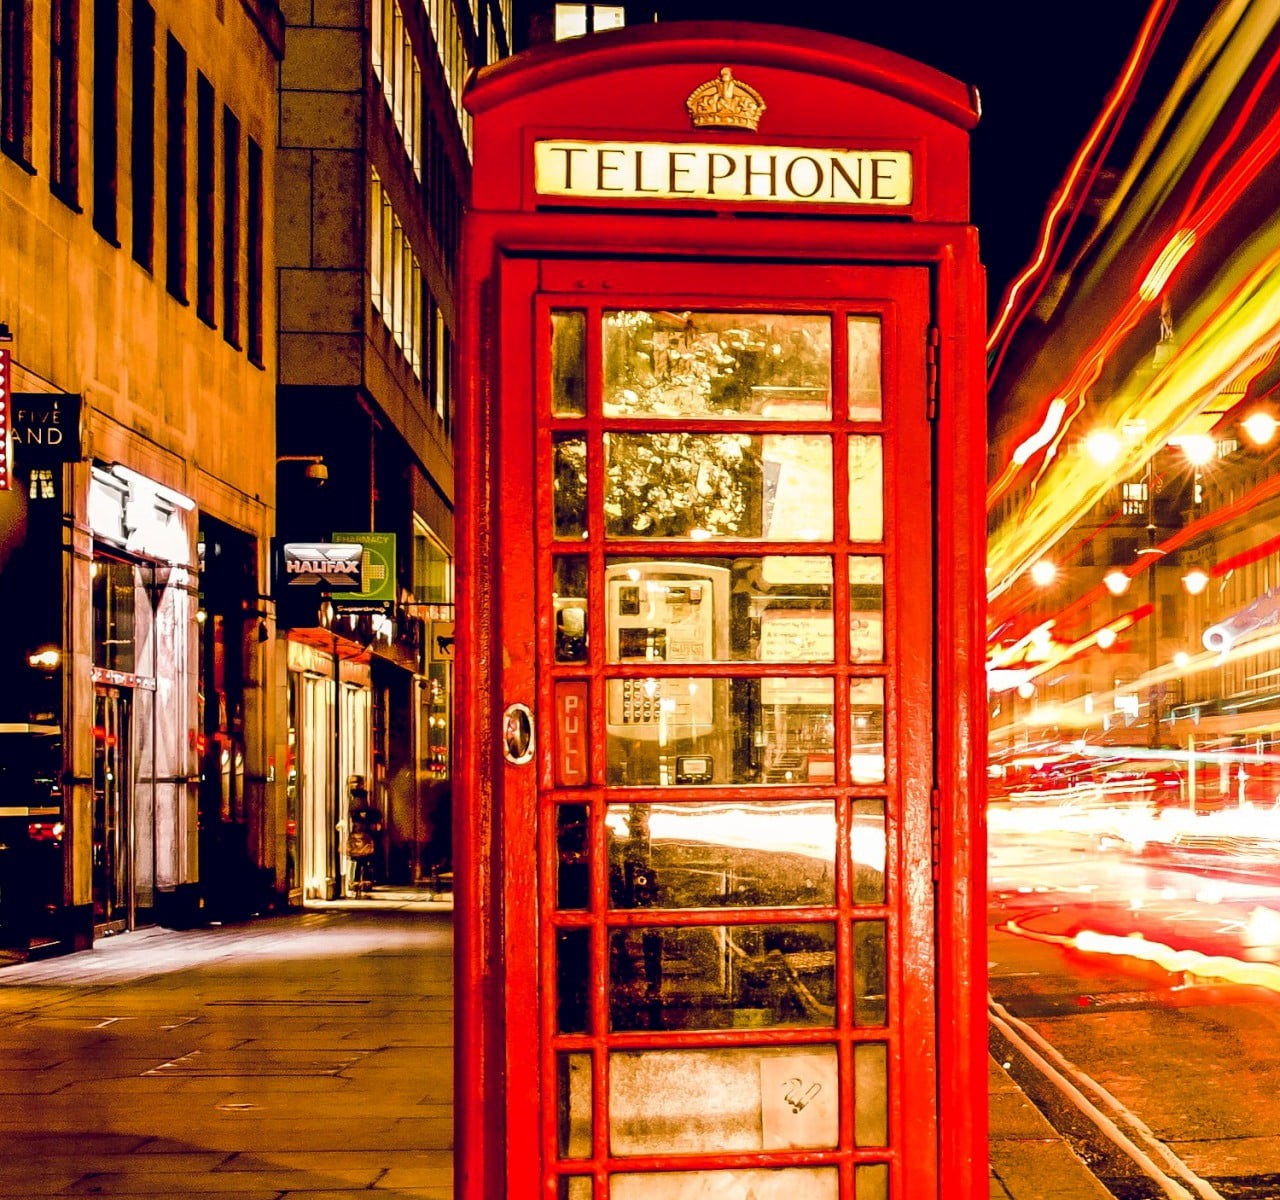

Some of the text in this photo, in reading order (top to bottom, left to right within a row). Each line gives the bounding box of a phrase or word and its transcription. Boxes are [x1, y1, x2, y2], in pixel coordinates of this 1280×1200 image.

[550, 148, 897, 200] TELEPHONE
[335, 535, 389, 544] PHARMACY
[286, 560, 360, 574] HALIFAX
[565, 695, 579, 775] PULL
